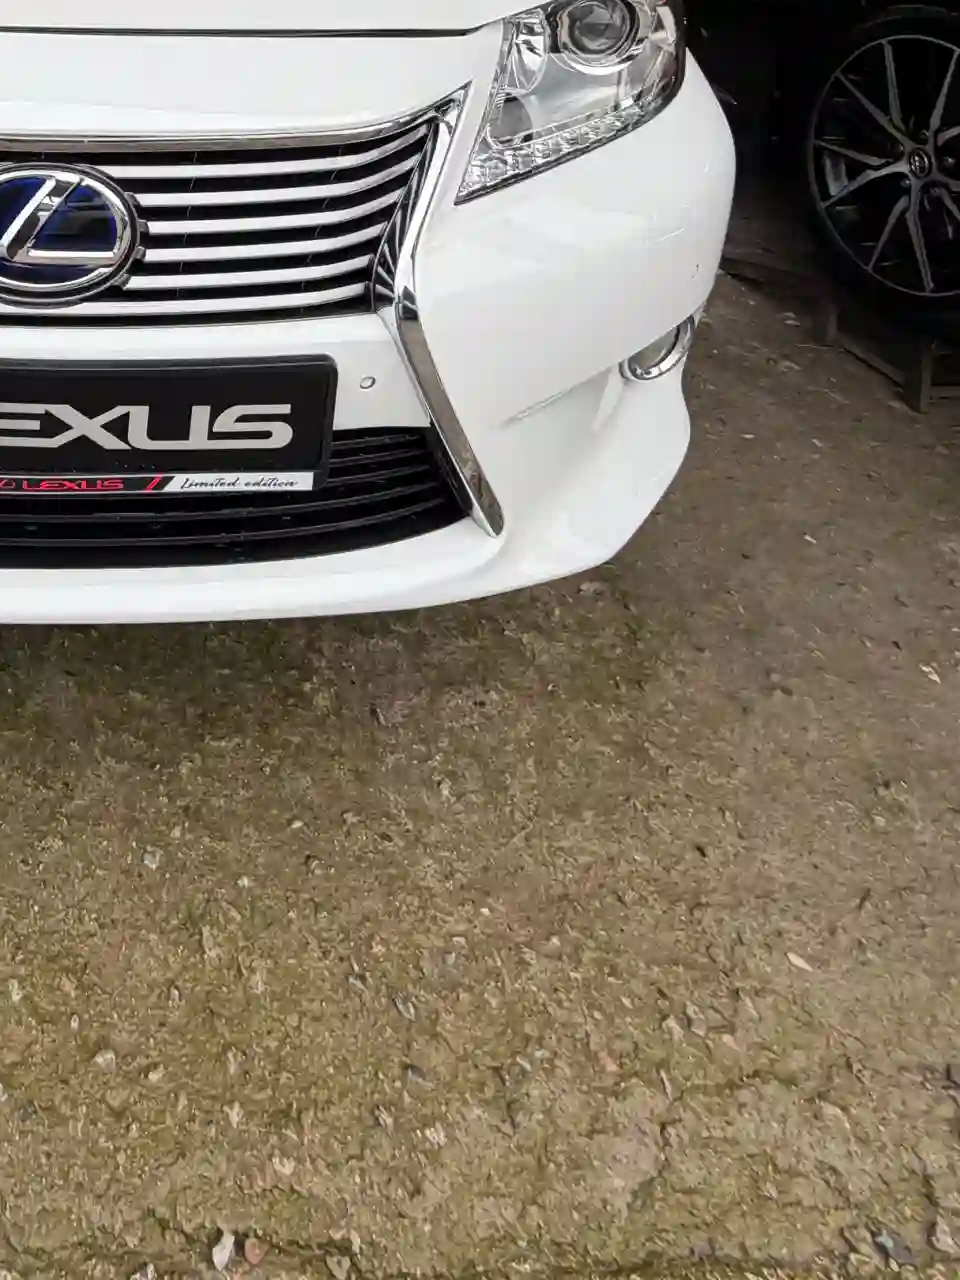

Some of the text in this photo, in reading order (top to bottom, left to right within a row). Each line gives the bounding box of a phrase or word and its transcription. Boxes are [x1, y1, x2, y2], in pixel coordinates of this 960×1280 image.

[22, 478, 125, 491] LEXUS
[179, 475, 299, 490] Limited edition
